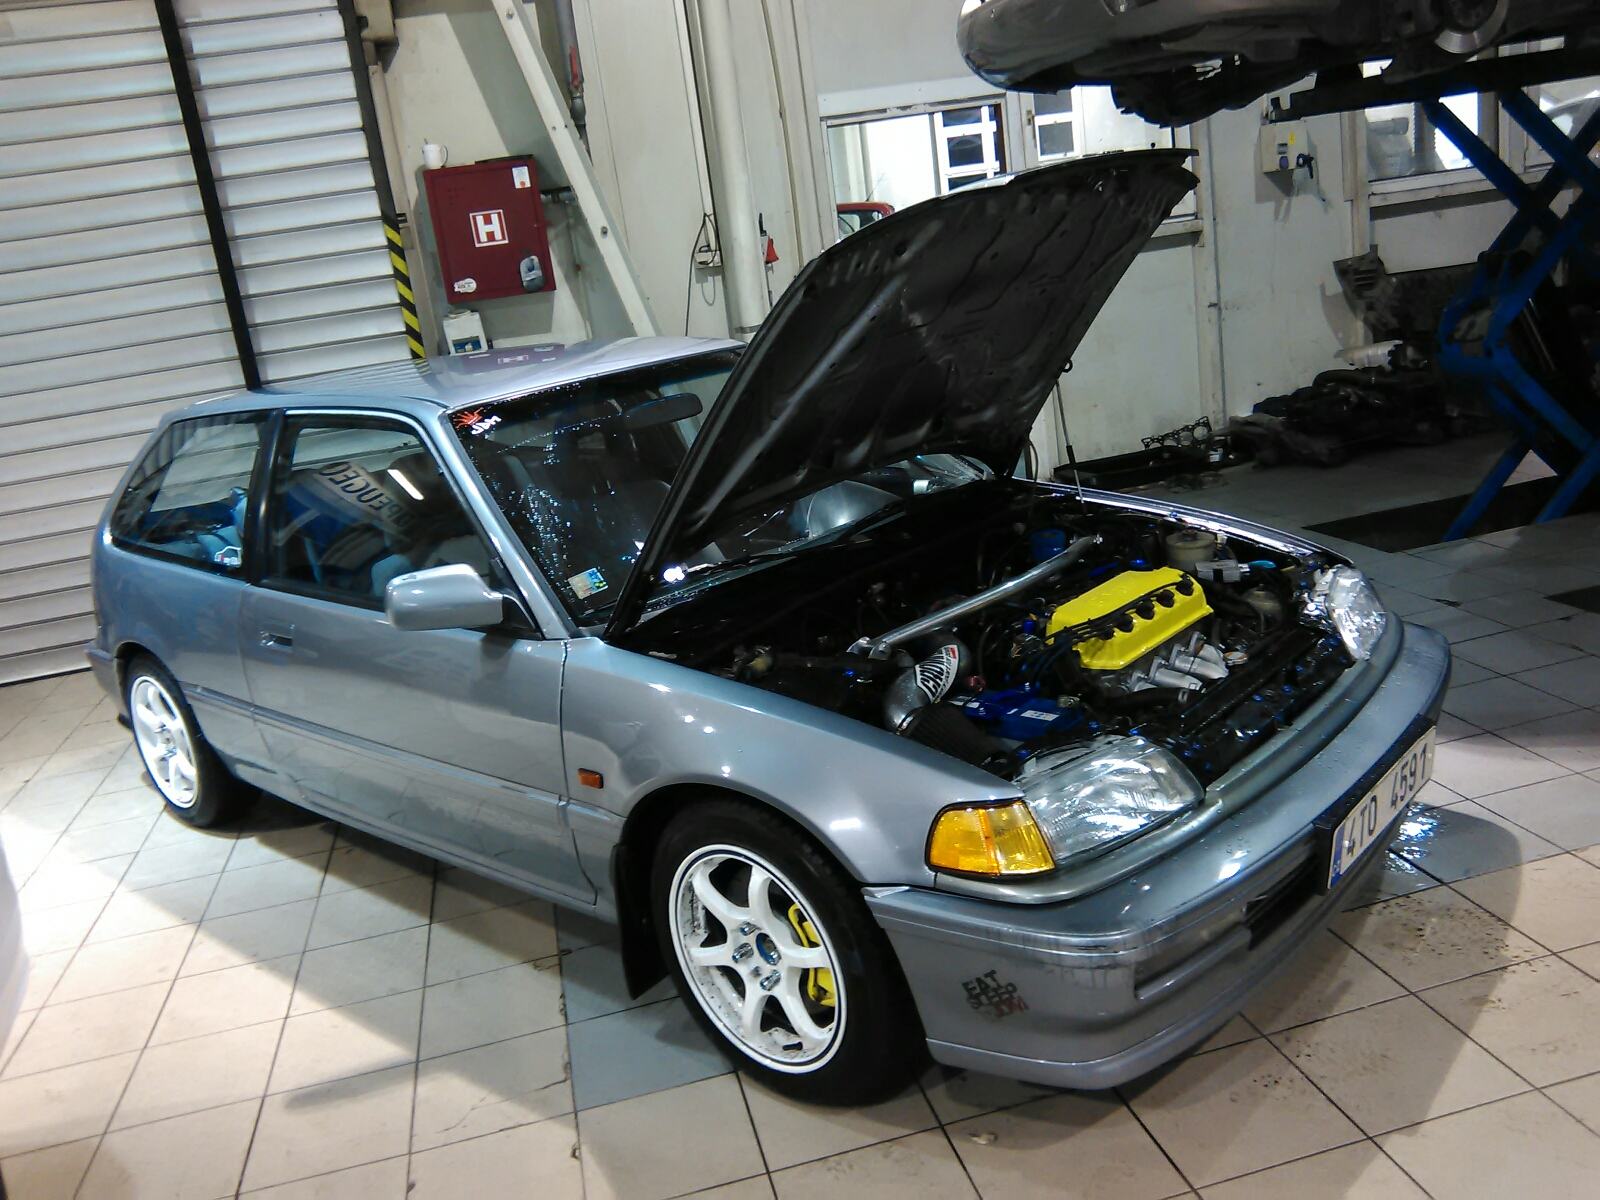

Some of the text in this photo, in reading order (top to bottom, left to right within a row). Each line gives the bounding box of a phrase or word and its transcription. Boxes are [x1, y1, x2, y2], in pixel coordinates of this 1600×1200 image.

[476, 213, 503, 242] H
[1390, 742, 1428, 810] 4591
[962, 969, 1001, 998] EAT
